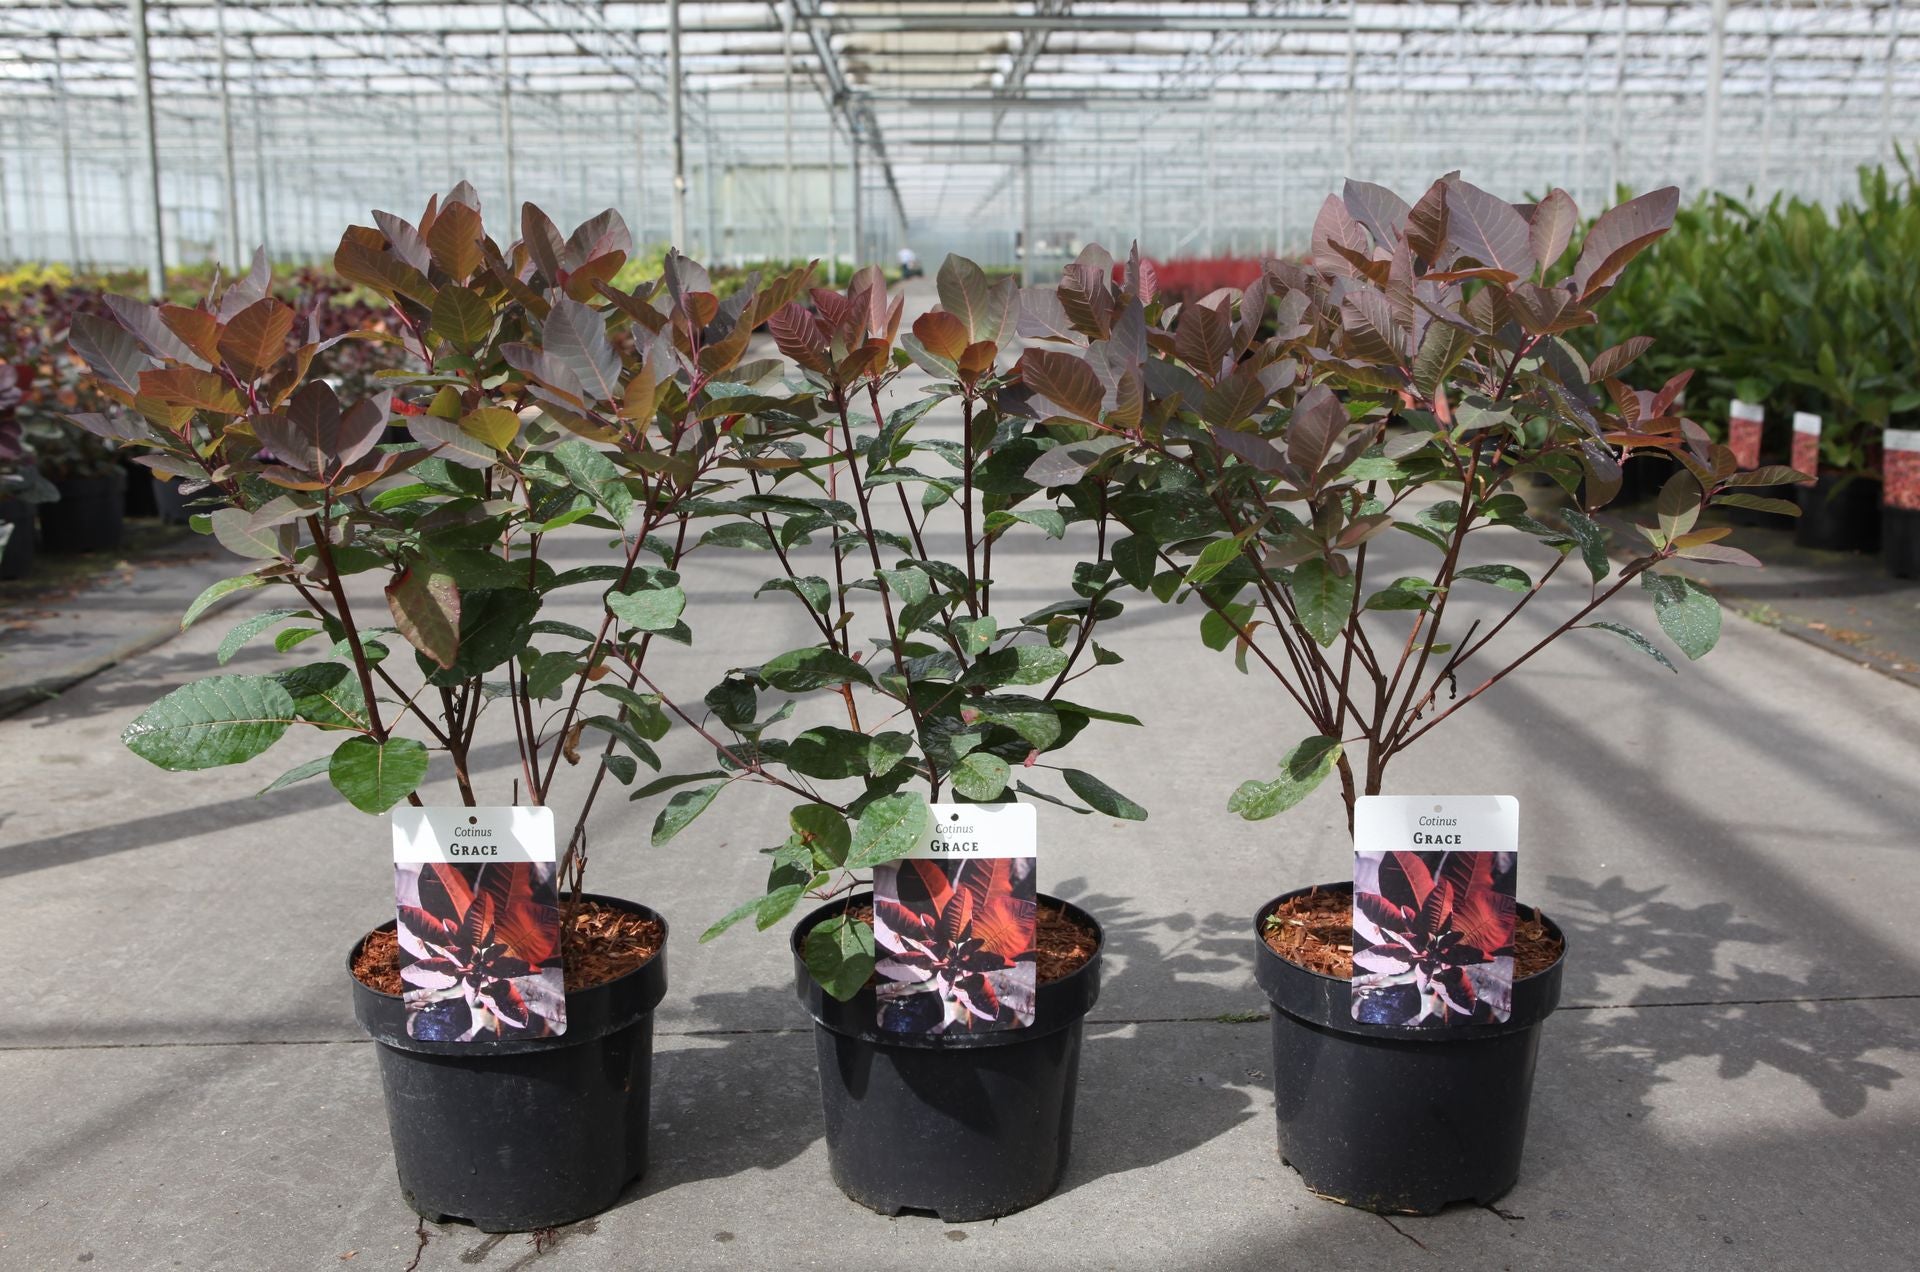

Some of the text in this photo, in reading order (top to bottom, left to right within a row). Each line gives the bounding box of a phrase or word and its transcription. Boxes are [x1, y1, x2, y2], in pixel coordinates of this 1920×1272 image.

[1418, 816, 1457, 827] Cotinus
[454, 826, 492, 837] Cotinus
[935, 823, 974, 834] Cotinus
[1413, 831, 1462, 844] GRACE
[450, 843, 498, 856] GRACE
[930, 840, 979, 852] GRACE
